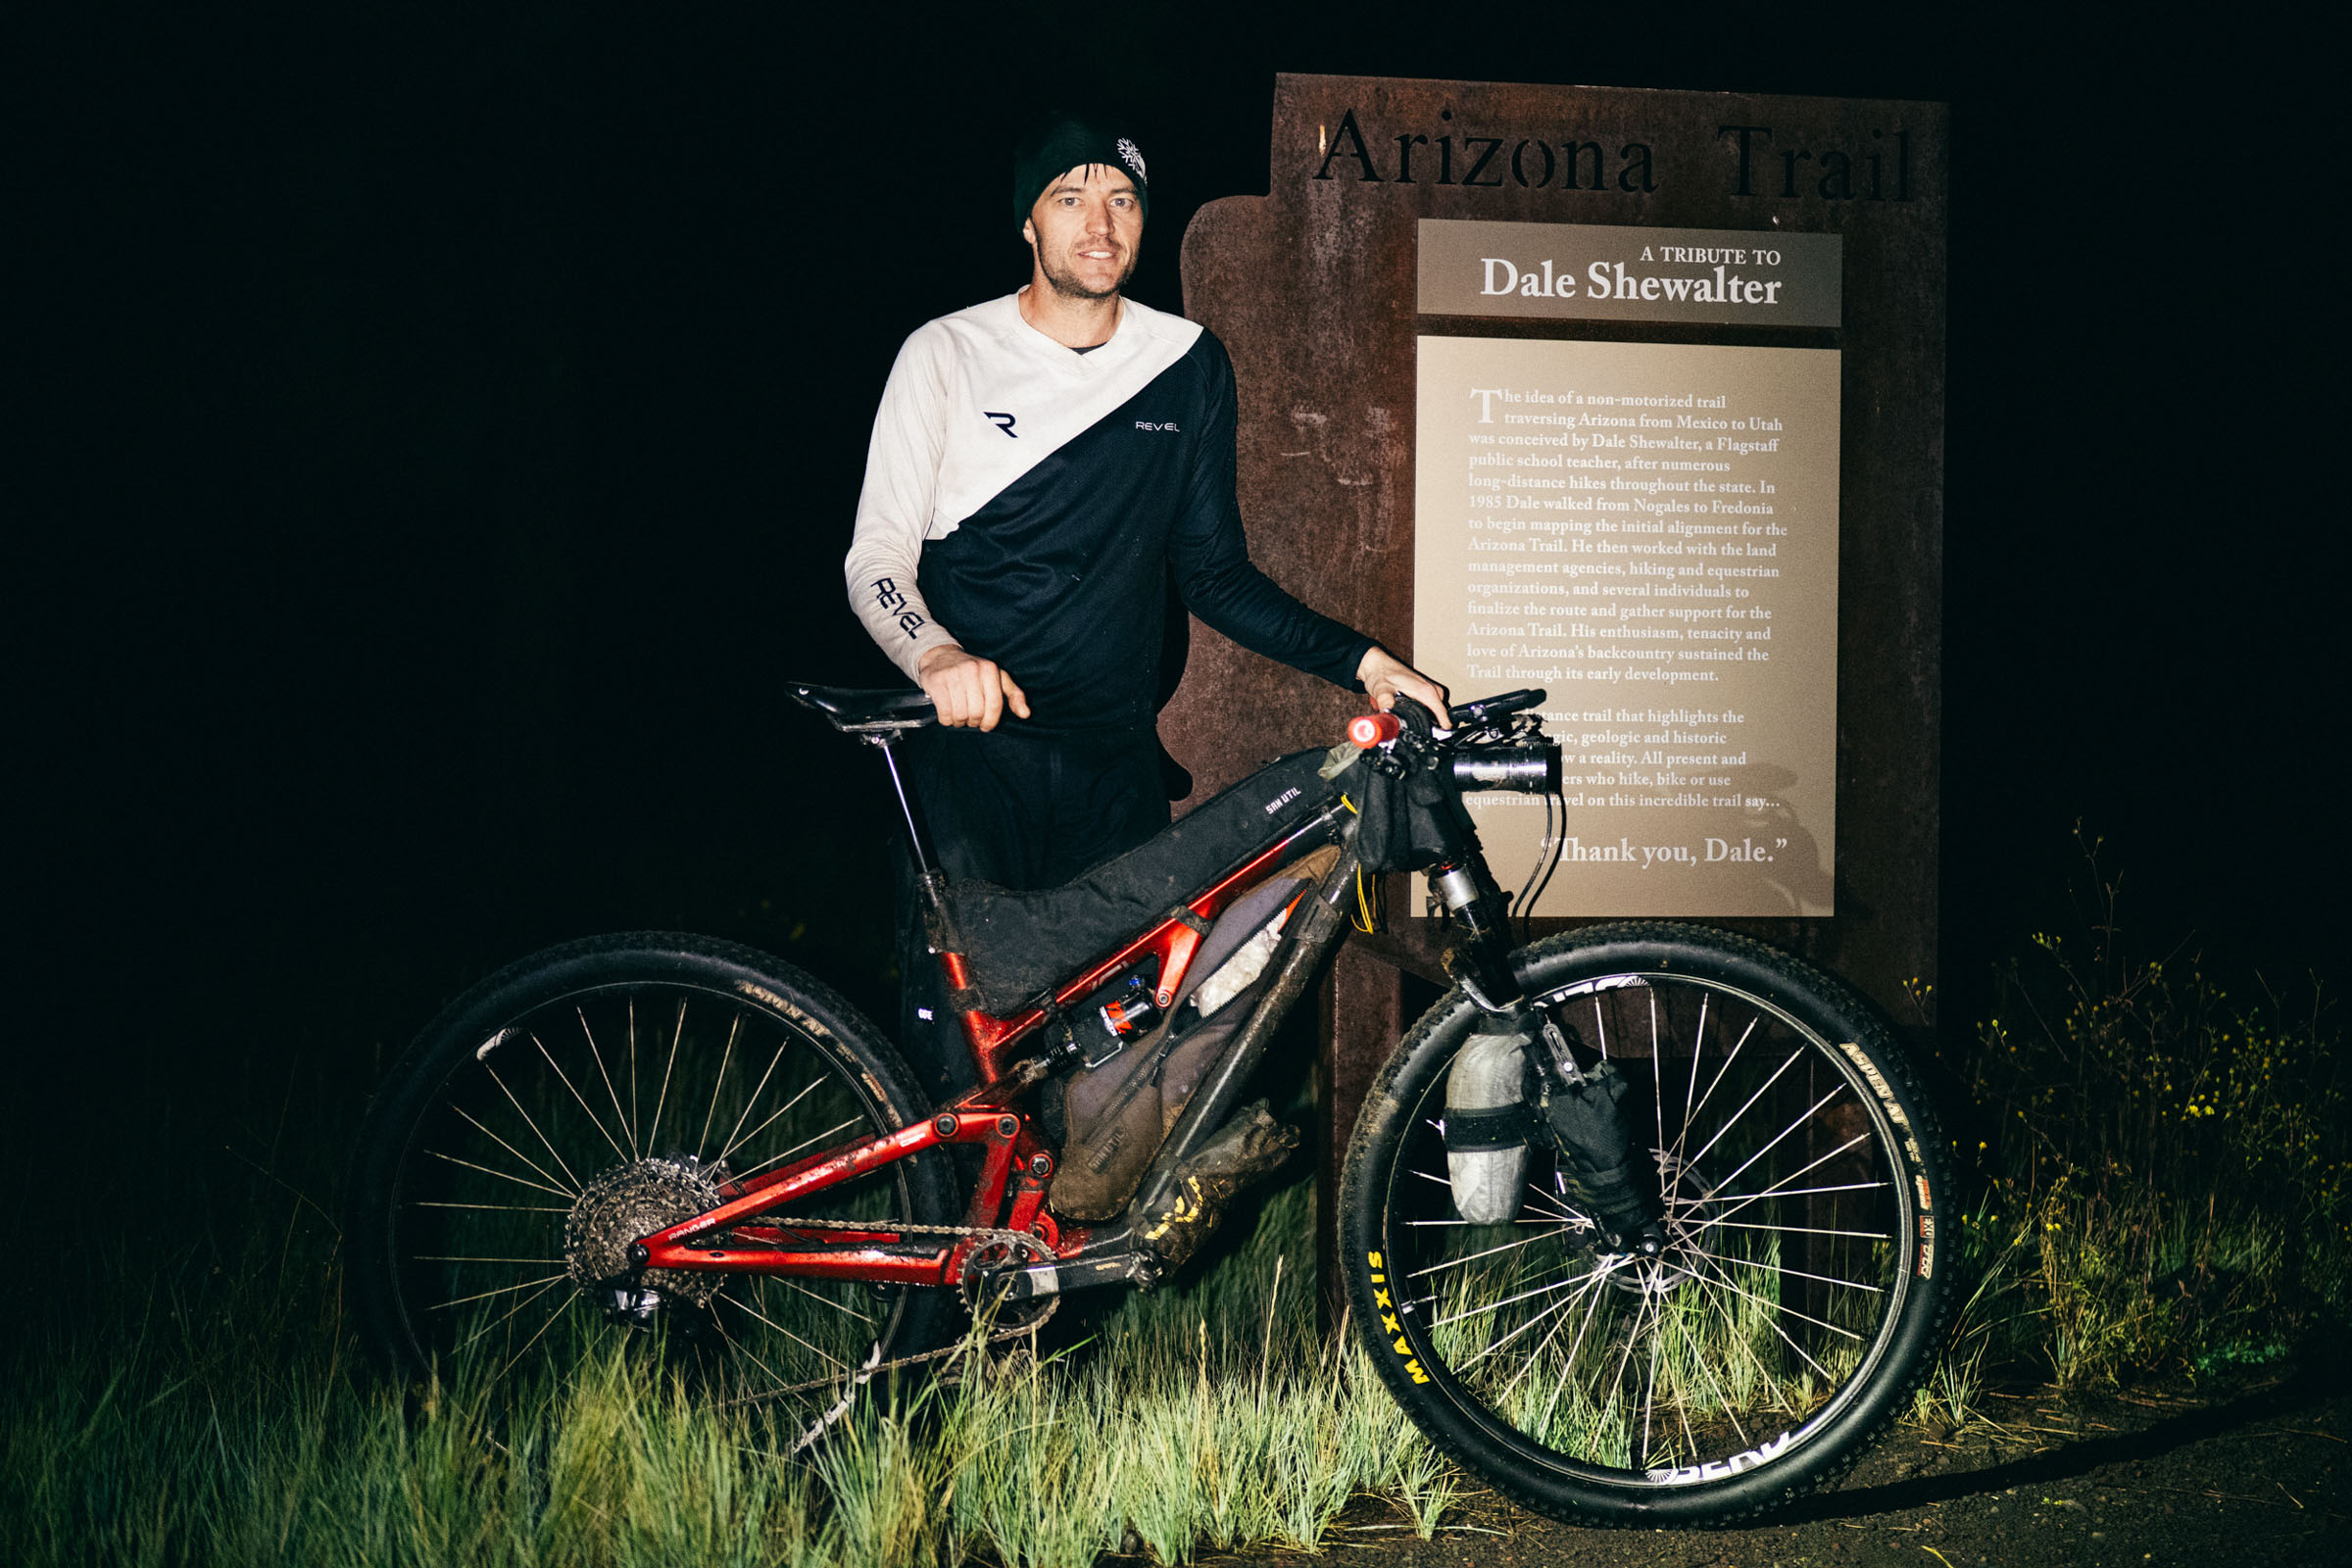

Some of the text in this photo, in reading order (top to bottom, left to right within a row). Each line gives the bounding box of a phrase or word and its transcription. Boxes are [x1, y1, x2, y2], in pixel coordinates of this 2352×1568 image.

[1312, 108, 1913, 203] Arizona Trail
[1640, 246, 1781, 266] A TRIBUTE TO
[1480, 258, 1782, 304] Dale Shewalter
[1525, 388, 1554, 404] idea
[1557, 389, 1573, 405] of
[1576, 394, 1584, 405] a
[1587, 392, 1692, 407] non-motorized
[1696, 395, 1726, 409] trail
[1136, 421, 1180, 432] REVEL
[1504, 413, 1783, 431] traversing Arizona from Mexico to Utah
[1468, 431, 1780, 456] was conceived by Dale Shewalter, a Flagstaff
[1469, 452, 1730, 471] public school teacher, after numerous
[1468, 473, 1775, 495] long-distance hikes throughout the state. In
[1469, 495, 1773, 516] 1985 Dale walked from Nogales to Fredonia
[1468, 516, 1788, 538] to begin mapping the initial alignment for the
[1469, 537, 1776, 557] Arizona Trail. He then worked with the land
[1468, 562, 1780, 581] management agencies, hiking and equestrian
[1468, 581, 1749, 598] organizations, and several individuals to
[870, 577, 925, 640] REVEL
[1468, 600, 1772, 622] finalize the route and gather support for the
[1468, 621, 1771, 643] Arizona Trail. His enthusiasm, tenacity and
[1468, 643, 1496, 658] love
[1500, 643, 1517, 658] of
[1588, 645, 1675, 663] backcountry
[1678, 646, 1742, 661] sustained
[1746, 647, 1769, 662] the
[1466, 663, 1719, 686] Trail through its early development.
[1583, 708, 1612, 722] trail
[1616, 708, 1643, 722] that
[1647, 709, 1718, 727] highlights
[1722, 710, 1744, 723] the
[1582, 728, 1640, 748] geologic
[1644, 729, 1669, 744] and
[1674, 730, 1726, 745] historic
[1579, 754, 1586, 763] a
[1590, 751, 1637, 768] reality.
[1641, 751, 1662, 764] All
[1667, 754, 1717, 769] present
[1721, 751, 1746, 765] and
[1587, 771, 1614, 786] who
[1620, 771, 1652, 786] hike,
[1657, 771, 1685, 786] bike
[1690, 776, 1703, 785] or
[1709, 776, 1730, 786] use
[1281, 787, 1301, 804] UTIL
[1465, 795, 1540, 809] equestrian
[1588, 797, 1604, 807] on
[1609, 792, 1635, 807] this
[1640, 792, 1708, 807] incredible
[1713, 793, 1740, 808] trail
[1642, 846, 1697, 870] you,
[1704, 838, 1788, 863] Dale.”
[1838, 1042, 1894, 1100] ASPEN
[667, 1217, 716, 1242] RANGER
[1368, 1251, 1431, 1385] MAXXIS
